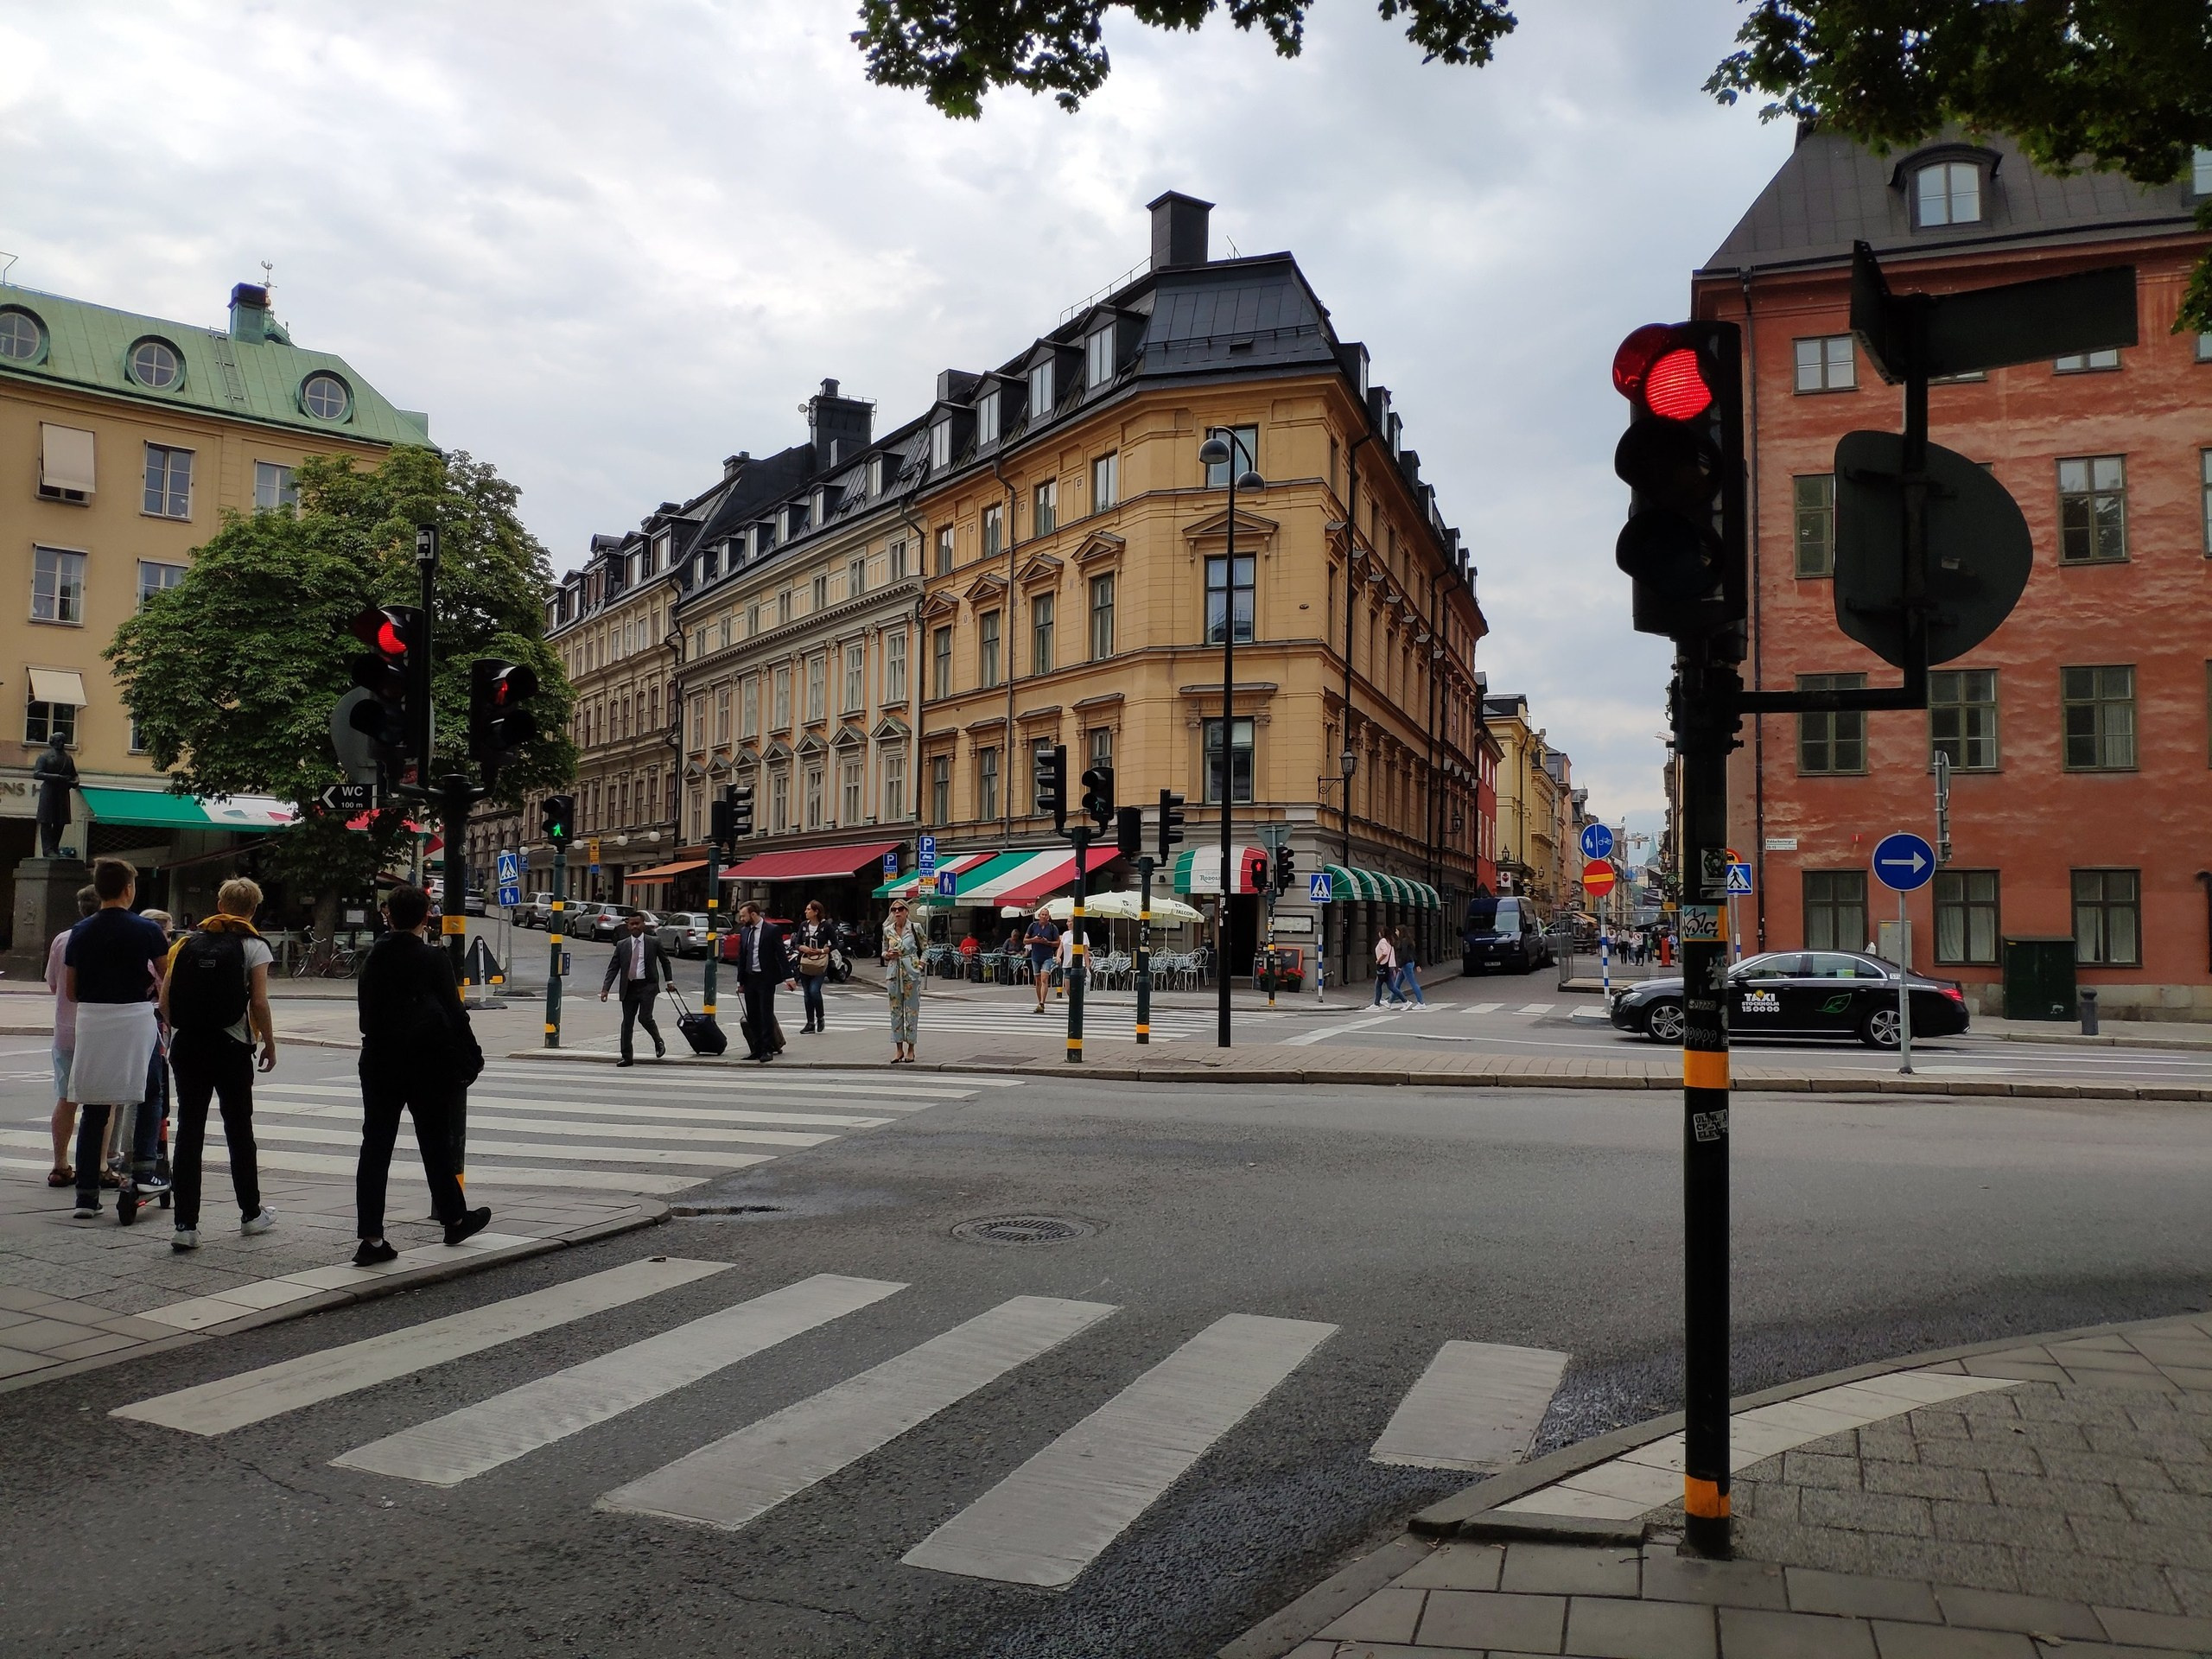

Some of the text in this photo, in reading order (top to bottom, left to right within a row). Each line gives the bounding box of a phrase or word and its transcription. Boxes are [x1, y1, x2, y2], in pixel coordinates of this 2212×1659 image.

[341, 786, 364, 797] WC
[923, 837, 932, 851] P
[887, 855, 894, 865] P
[1123, 909, 1138, 918] FALCON
[1744, 993, 1776, 1001] TAXI
